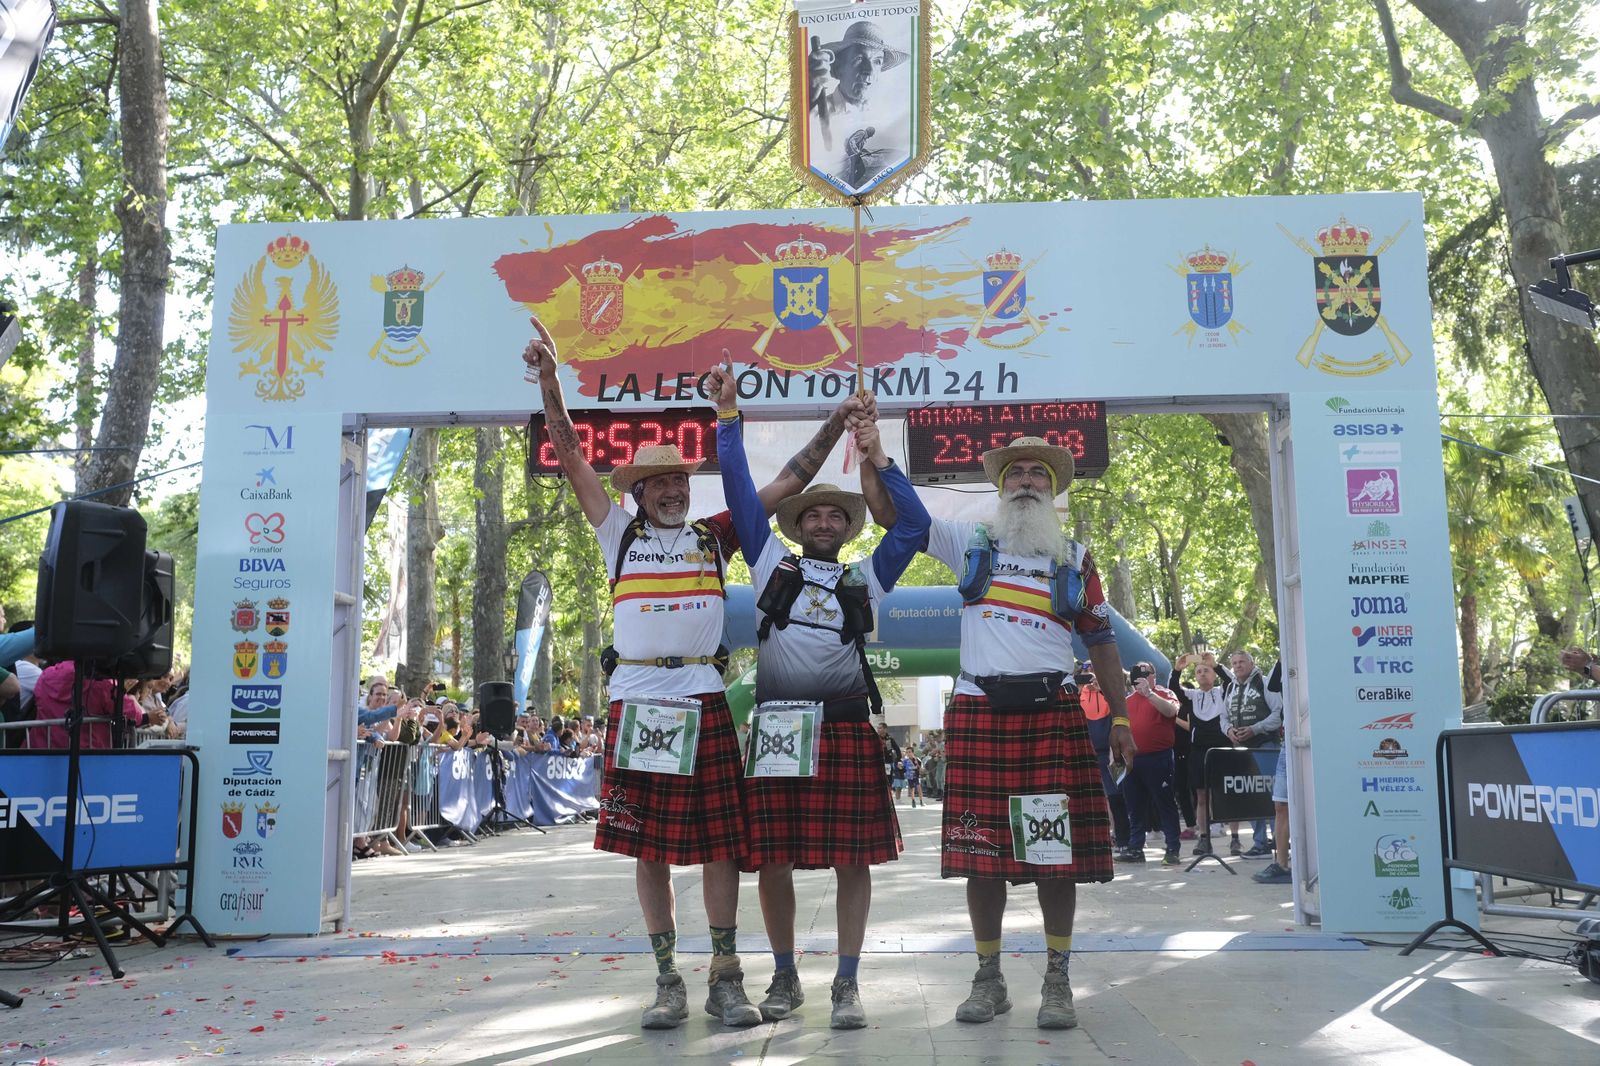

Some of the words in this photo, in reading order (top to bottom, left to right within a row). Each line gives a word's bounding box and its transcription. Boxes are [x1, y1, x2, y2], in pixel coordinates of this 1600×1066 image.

[801, 15, 824, 25] UNO
[827, 12, 857, 23] IGUAL
[858, 9, 880, 20] QUE
[882, 6, 918, 18] TODOS
[873, 167, 895, 185] PACO
[597, 374, 642, 402] LA
[803, 371, 858, 398] 101
[871, 366, 931, 397] KM
[943, 371, 984, 402] 24
[997, 363, 1019, 394] h
[1333, 423, 1388, 436] asisa
[240, 488, 292, 501] CaixaBank
[249, 545, 283, 554] Primaflor
[239, 558, 287, 573] BBVA
[1351, 562, 1406, 573] Fundación
[233, 577, 292, 592] Seguros
[1348, 575, 1410, 585] MAPFRE
[889, 605, 941, 621] diputación
[943, 606, 956, 617] de
[1377, 624, 1413, 637] INTER
[1377, 636, 1414, 648] SPORT
[1376, 660, 1415, 674] TRC
[234, 688, 280, 700] PULEVA
[1358, 688, 1412, 701] CeraBike
[231, 729, 278, 738] POWERADE
[223, 776, 282, 787] Diputación
[228, 787, 242, 798] de
[245, 787, 276, 798] Cádiz
[1029, 818, 1065, 842] 920
